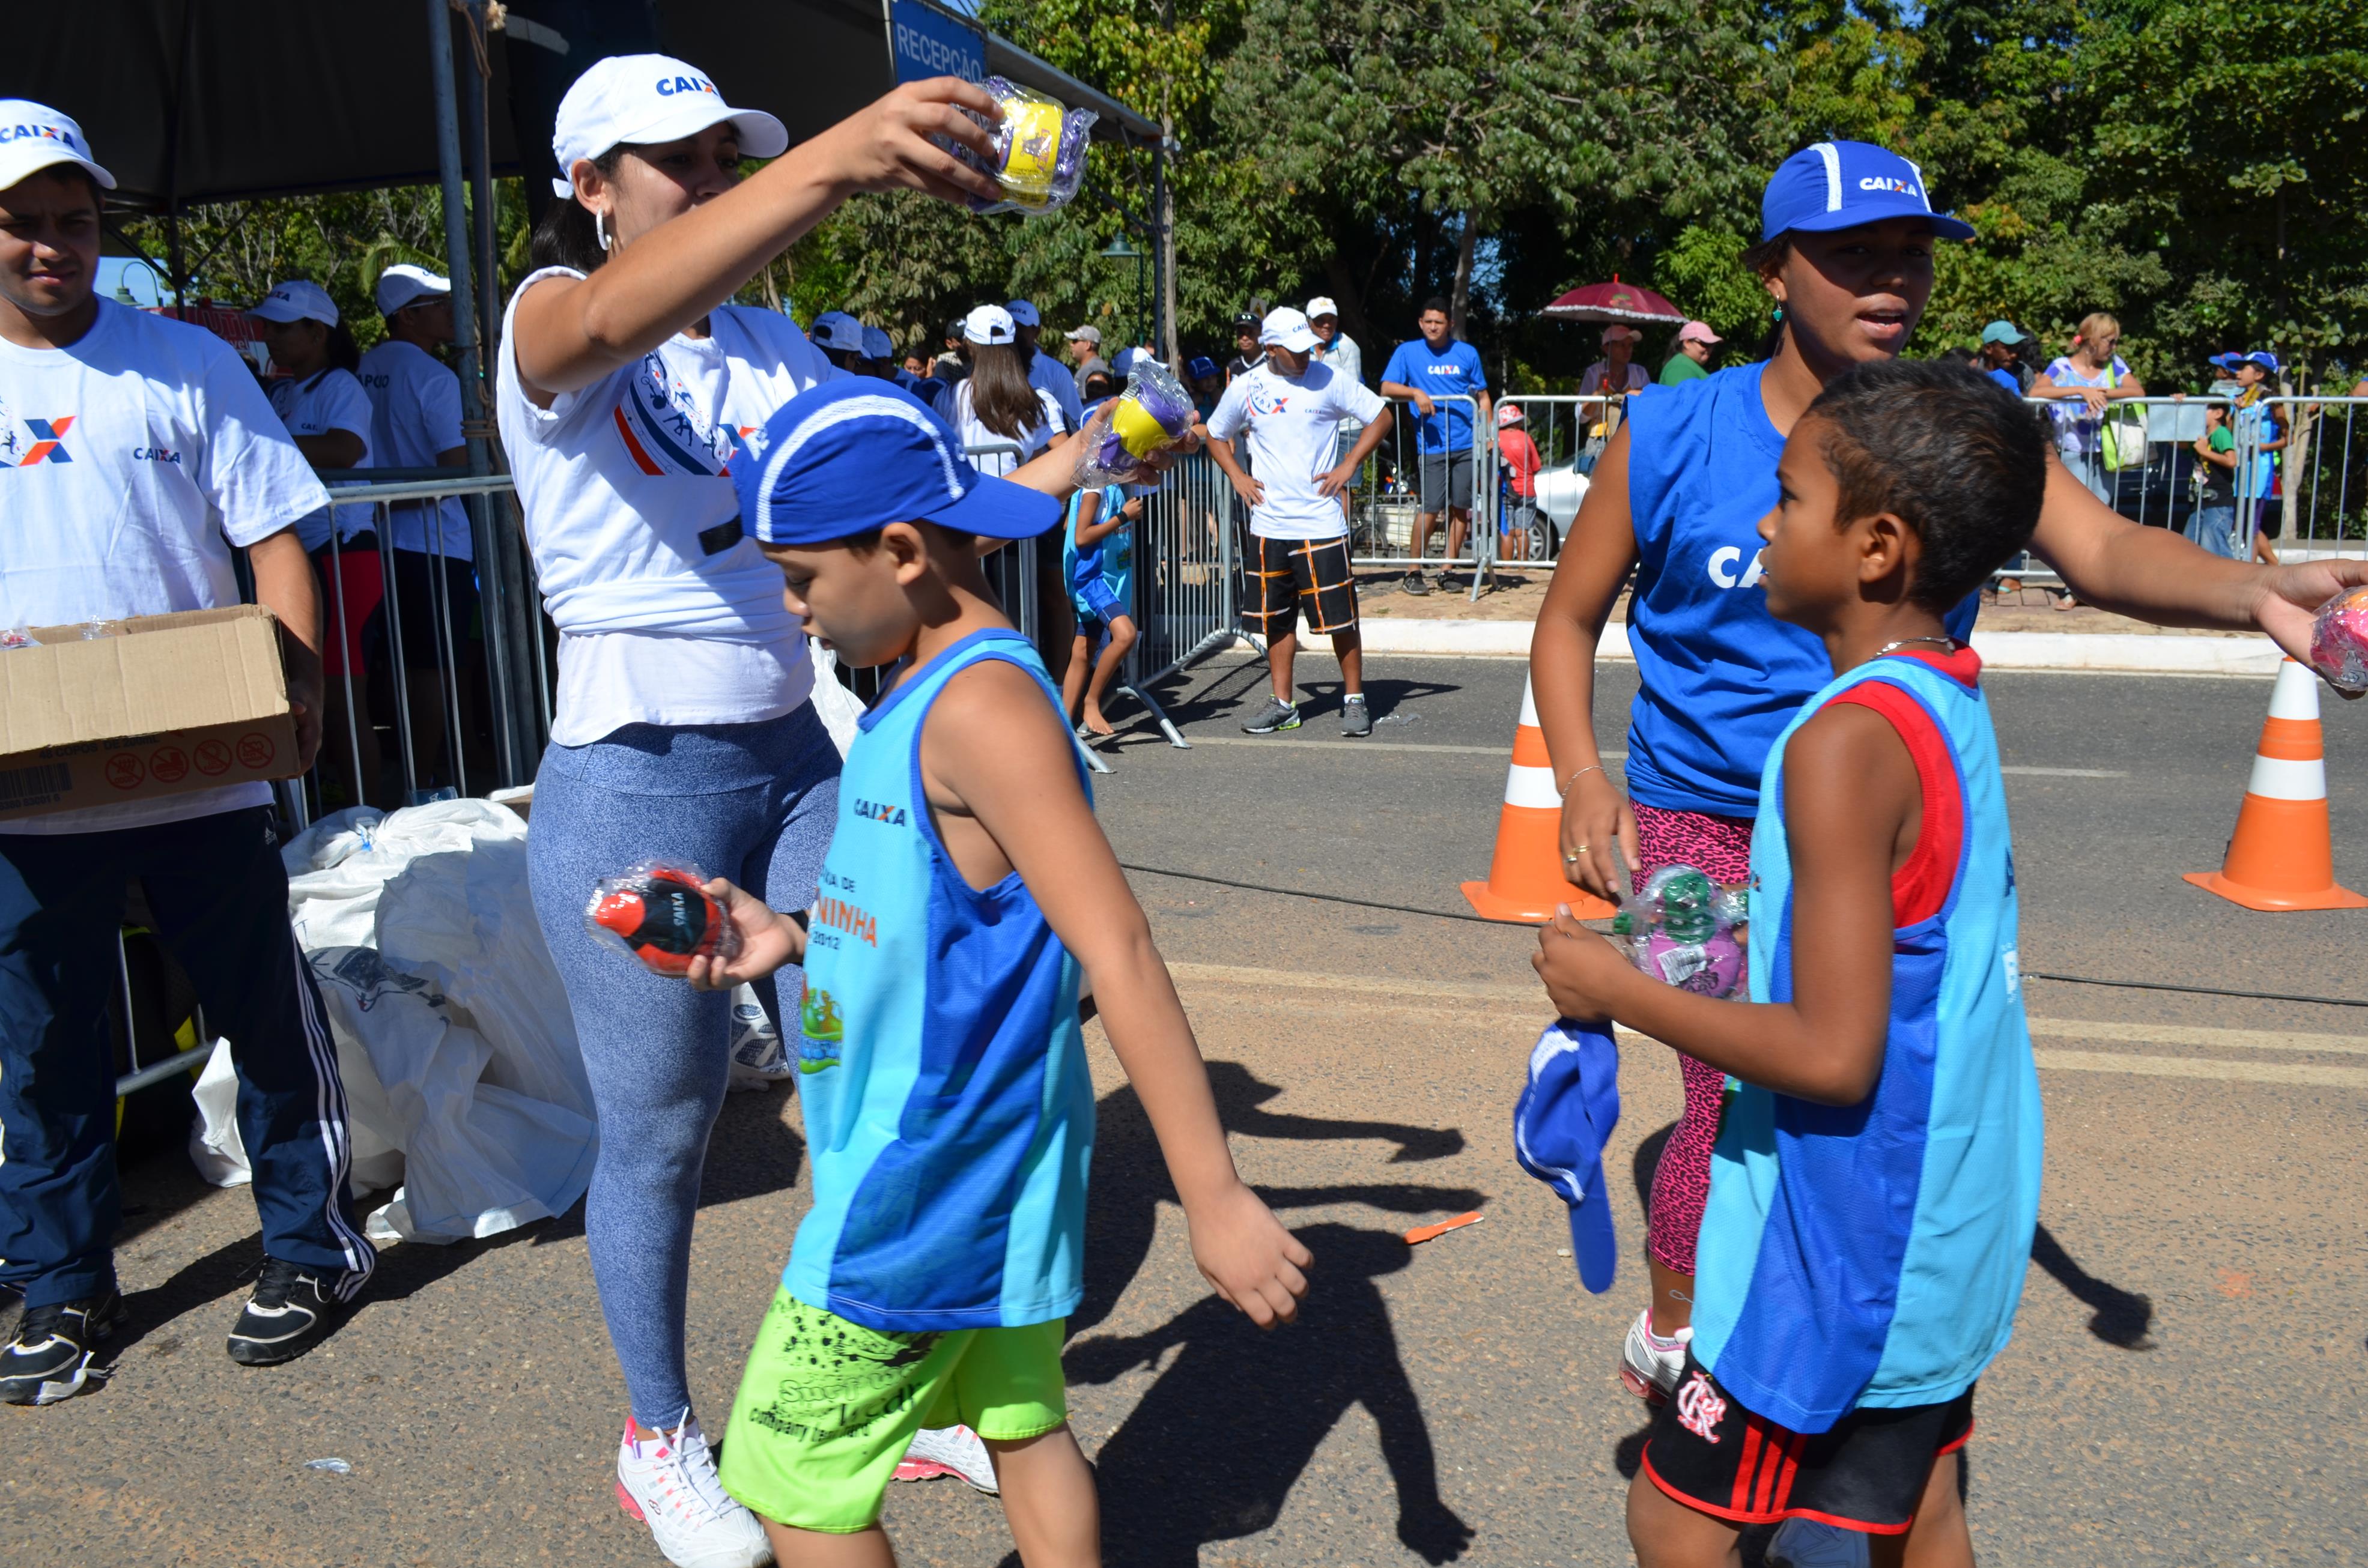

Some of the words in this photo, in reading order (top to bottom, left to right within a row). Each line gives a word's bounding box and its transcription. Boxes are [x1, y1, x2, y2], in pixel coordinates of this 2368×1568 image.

[0, 124, 76, 150] CAIXA
[1859, 177, 1918, 197] CAIXA
[1427, 365, 1460, 375] CAIXA
[133, 447, 181, 464] CAIXA
[56, 742, 98, 757] COPOS
[104, 739, 121, 749] DE
[854, 798, 906, 827] CAIXA
[671, 892, 686, 927] CAIXA
